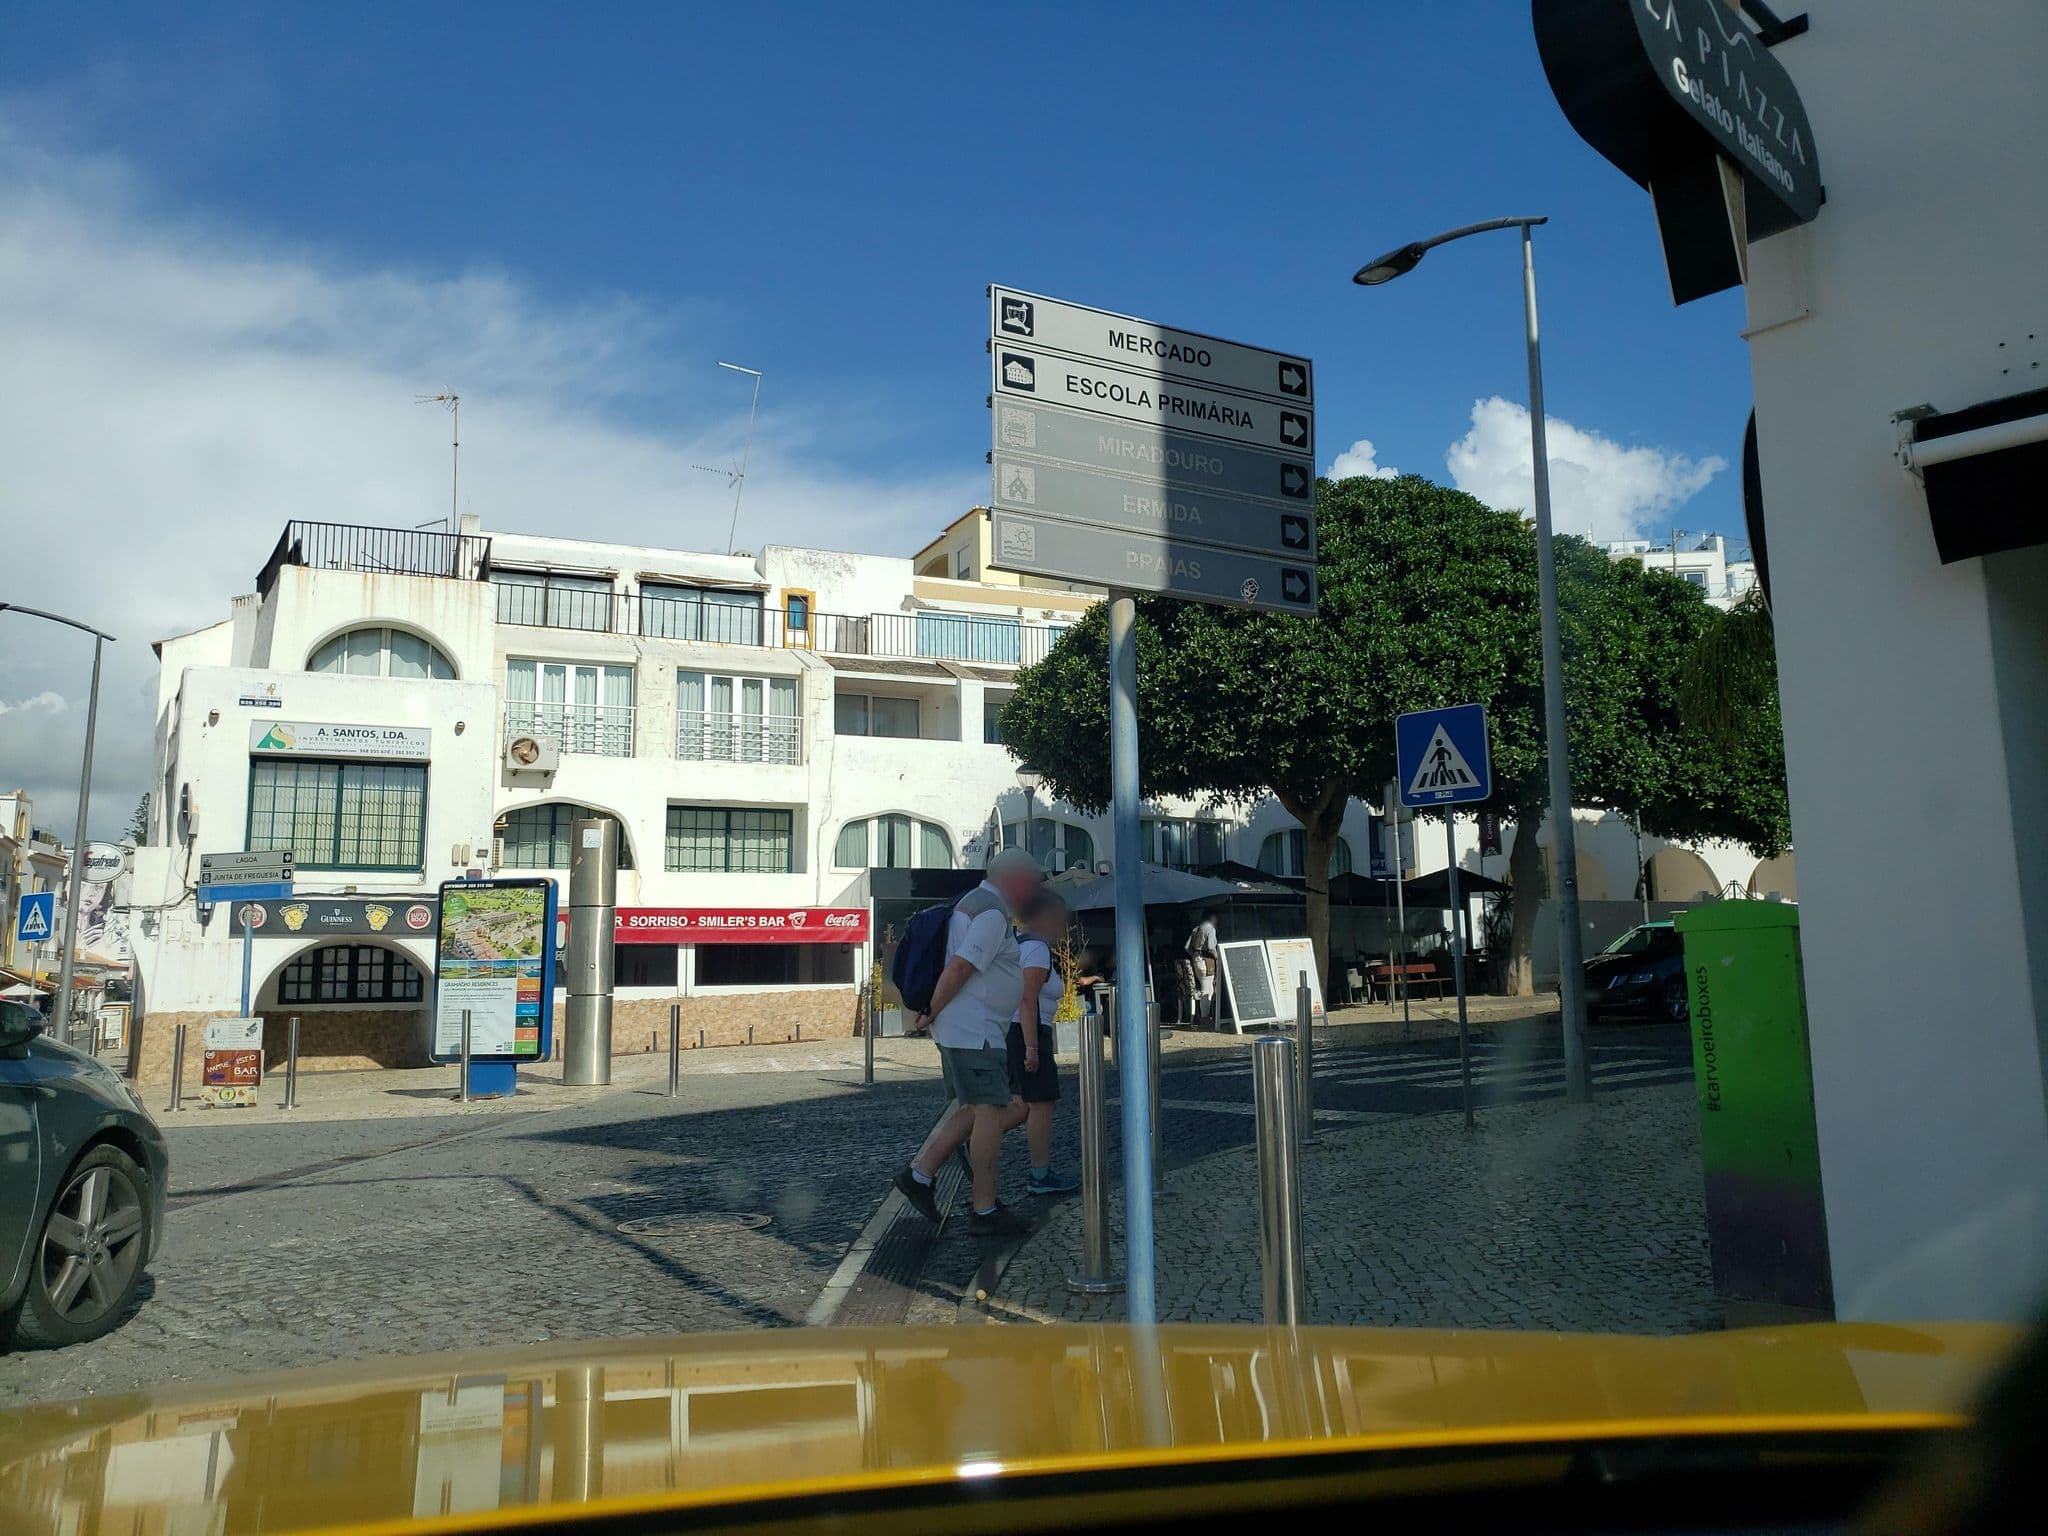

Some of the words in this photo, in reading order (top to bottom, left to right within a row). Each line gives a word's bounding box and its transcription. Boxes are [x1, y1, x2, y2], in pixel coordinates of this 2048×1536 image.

[1697, 26, 1806, 167] PIAZZA
[1672, 56, 1734, 134] Gelato
[1735, 113, 1794, 193] Italiano
[1108, 329, 1212, 369] MERCADO
[1066, 373, 1152, 409] ESCOLA
[1158, 392, 1254, 430] PRIMÁRIA
[1098, 435, 1225, 475] MIRADOURO
[1122, 494, 1202, 525] ERMIDA
[317, 727, 329, 738] A.
[332, 728, 380, 740] SANTOS,
[382, 730, 408, 741] LDA.
[213, 873, 233, 881] JUNTA
[234, 872, 243, 880] DE
[244, 870, 280, 880] FREGUESIA
[235, 856, 258, 864] LAGOA
[320, 914, 353, 923] GUINNESS
[629, 916, 688, 927] SORRISO
[698, 916, 756, 927] SMILER'S
[759, 916, 785, 927] BAR
[1695, 966, 1721, 1113] #carvoeiroboxes
[234, 1067, 257, 1075] BAR
